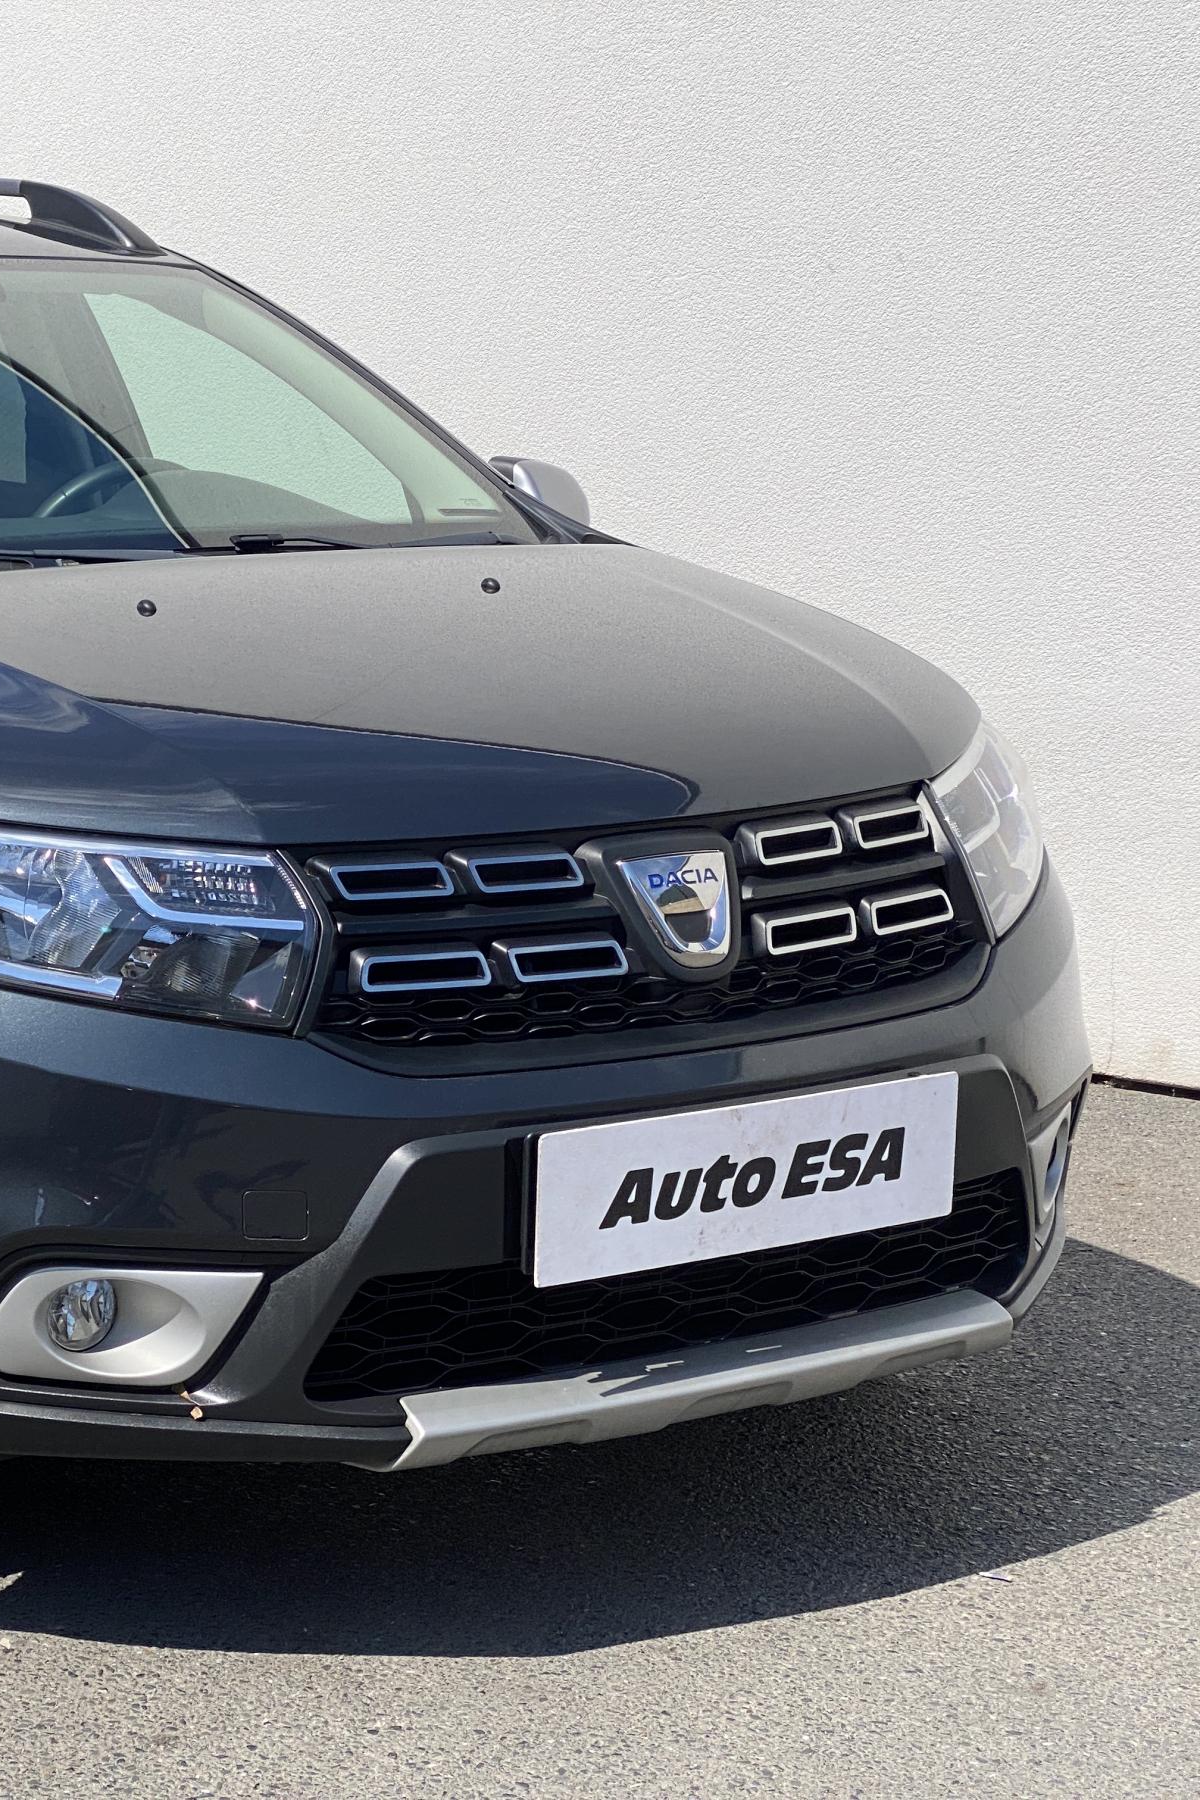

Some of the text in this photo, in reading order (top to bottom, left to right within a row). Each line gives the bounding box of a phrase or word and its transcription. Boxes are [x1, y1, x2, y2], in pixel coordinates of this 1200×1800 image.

[648, 868, 718, 889] DACIA
[598, 1126, 905, 1230] Auto ESA
